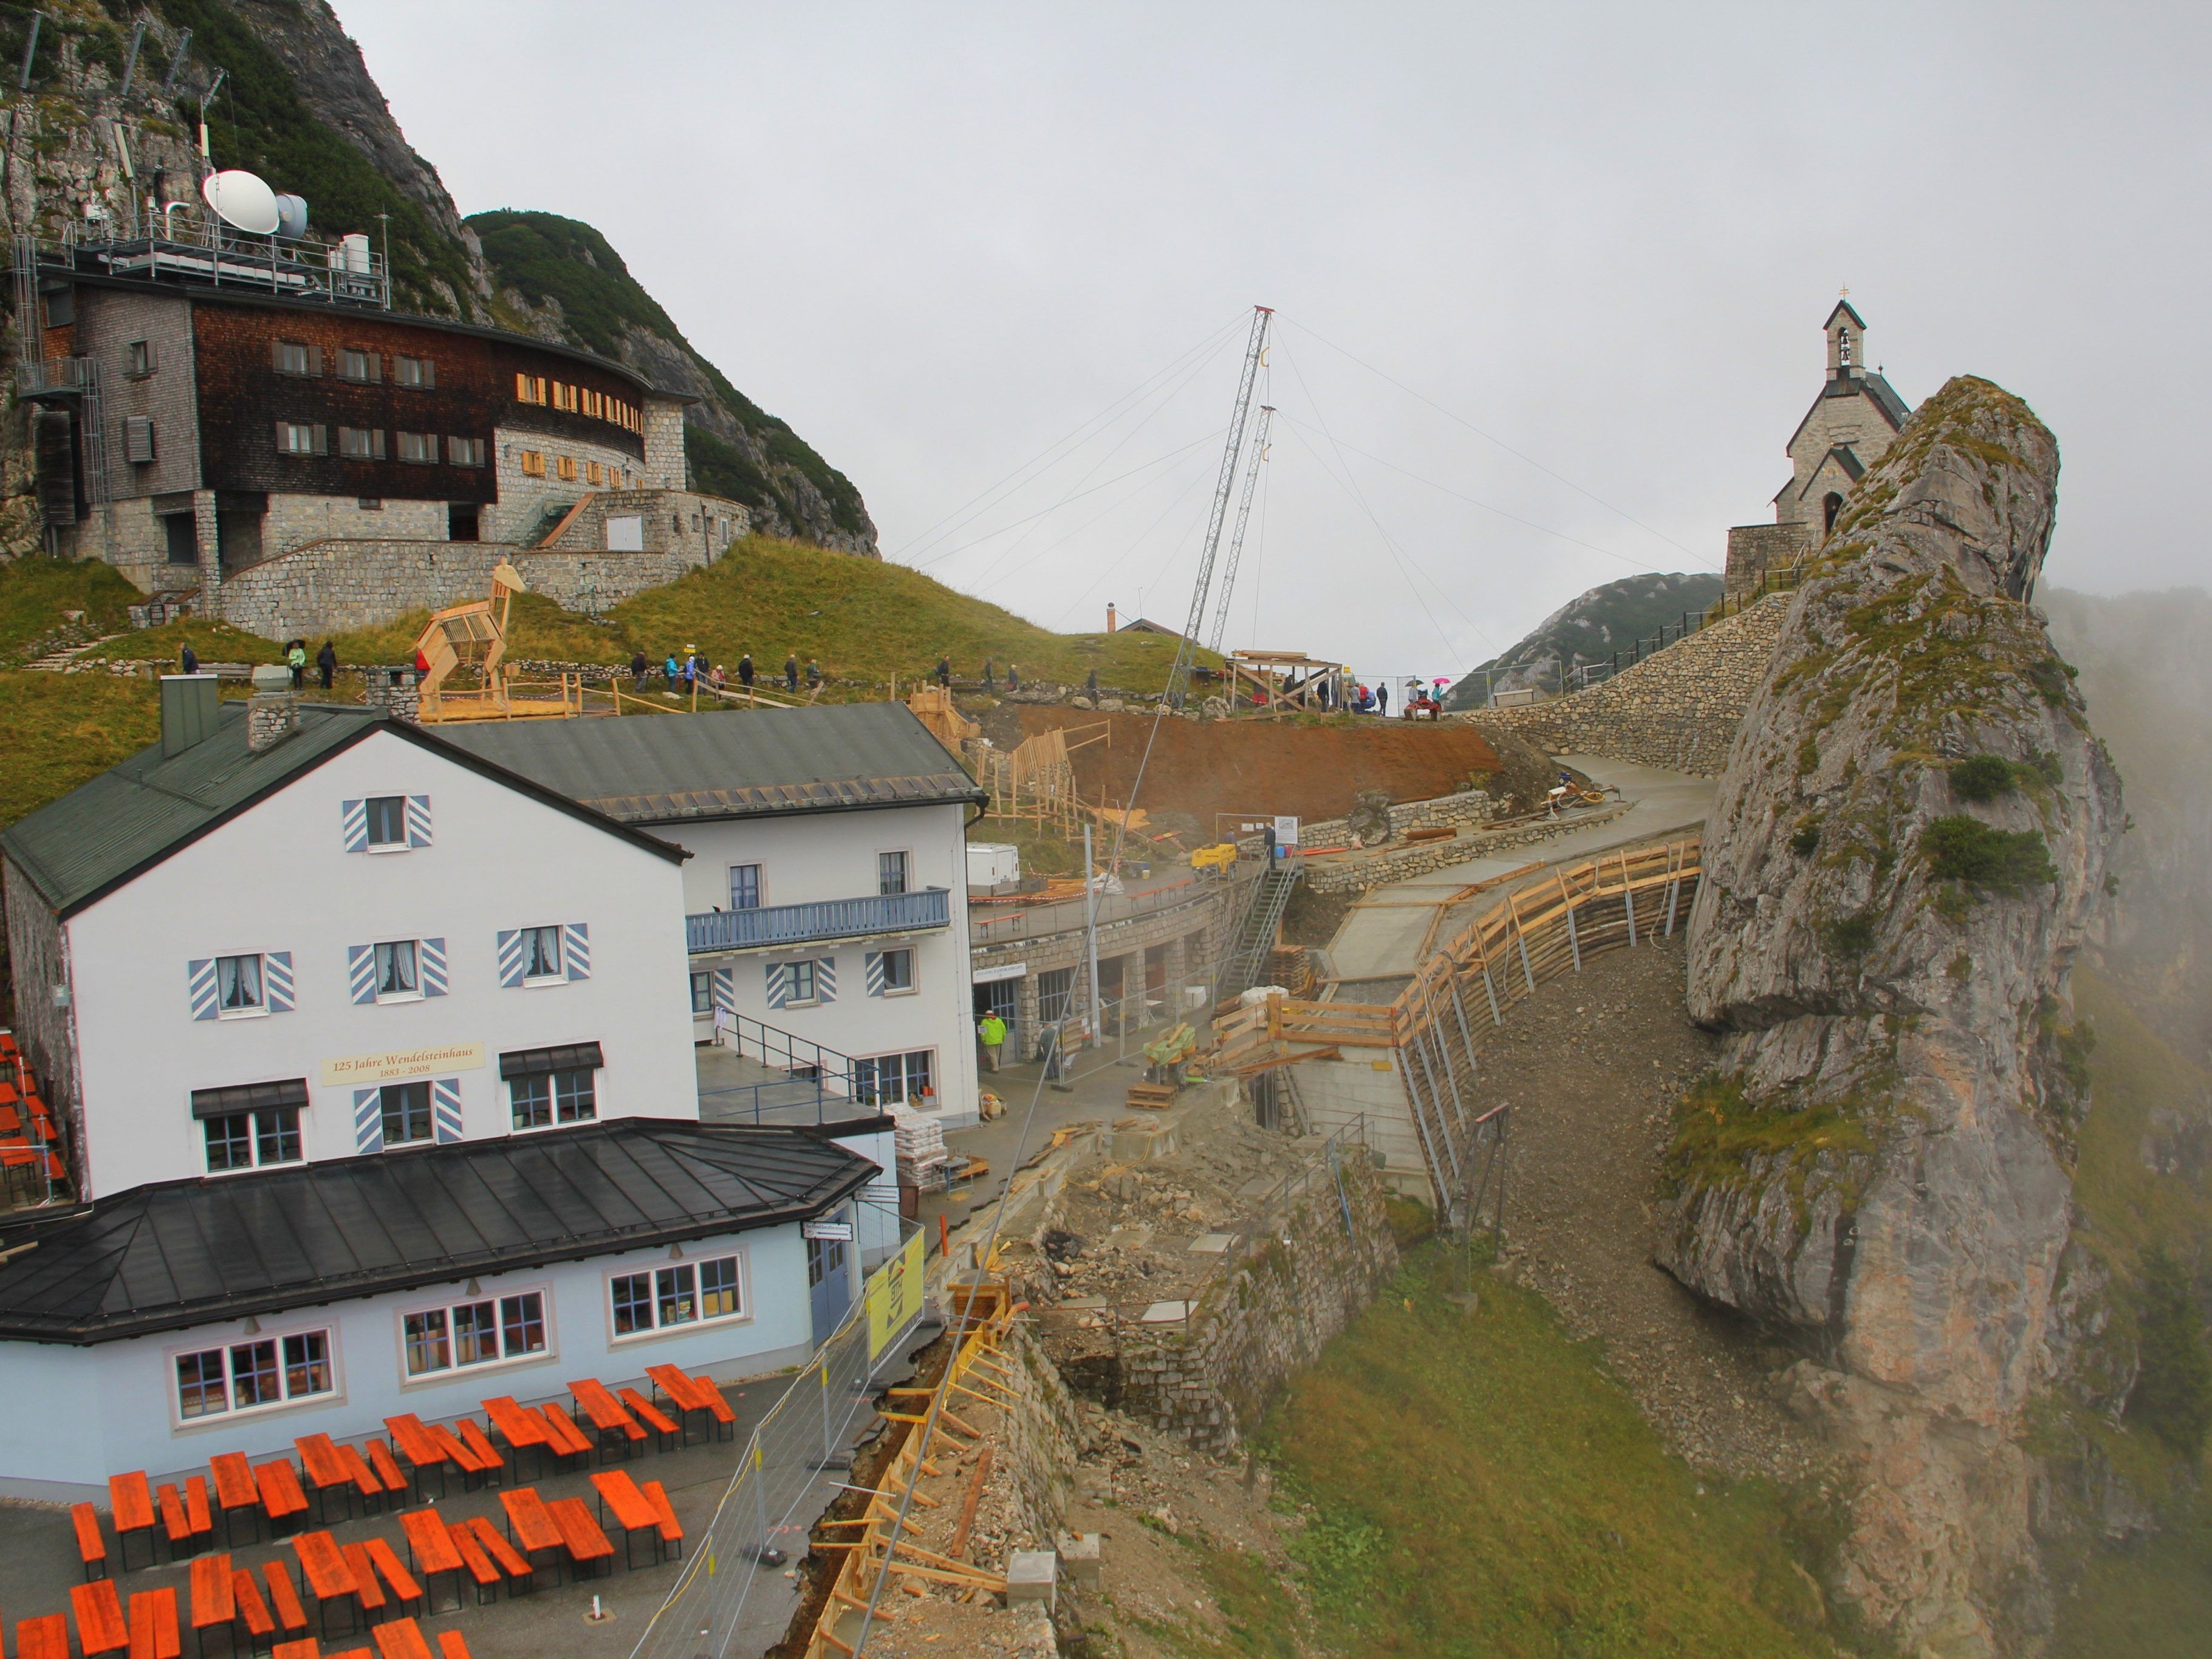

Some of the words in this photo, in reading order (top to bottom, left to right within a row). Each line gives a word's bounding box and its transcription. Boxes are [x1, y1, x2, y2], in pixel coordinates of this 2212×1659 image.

[334, 1061, 351, 1071] 125
[355, 1057, 382, 1070] Jahre
[386, 1048, 473, 1065] Wendelsteinhaus
[380, 1069, 399, 1078] 1883
[408, 1065, 430, 1074] 2008
